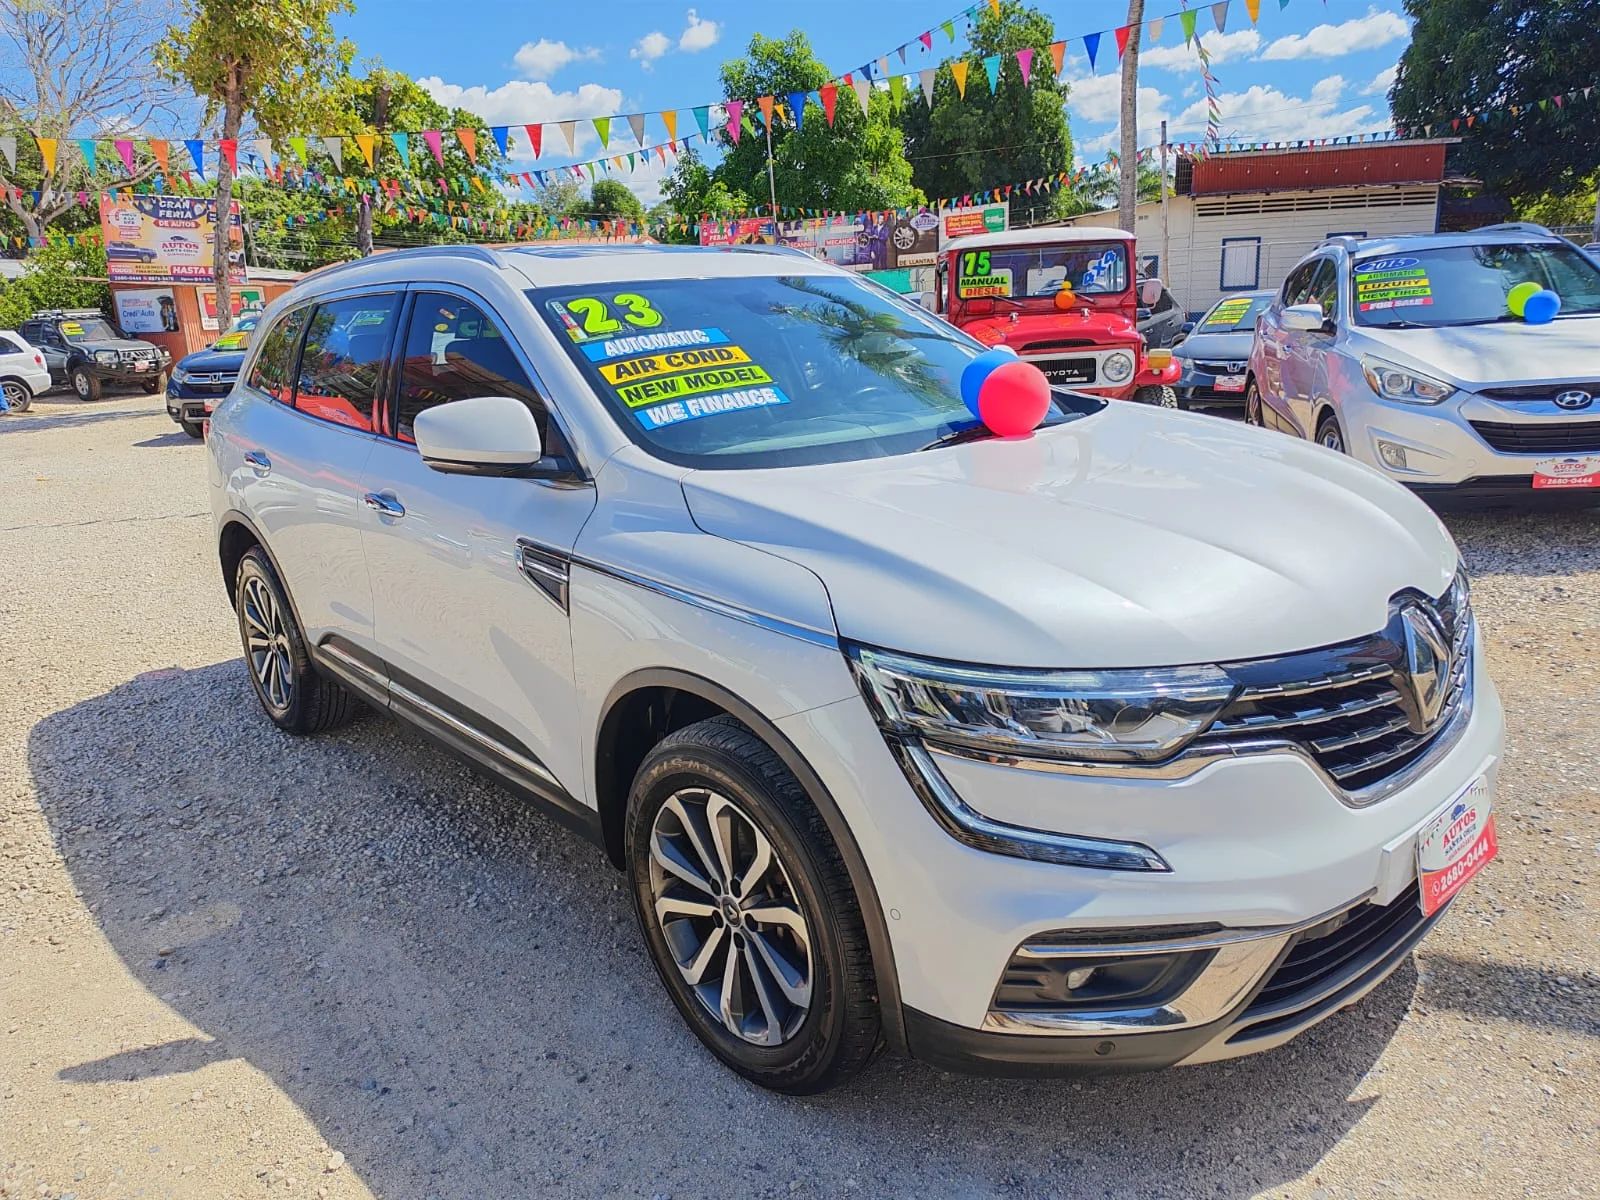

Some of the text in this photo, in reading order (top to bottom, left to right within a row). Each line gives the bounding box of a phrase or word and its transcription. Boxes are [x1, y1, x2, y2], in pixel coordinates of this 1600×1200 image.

[159, 200, 190, 209] GRAN
[159, 210, 193, 219] FERIA
[161, 242, 200, 250] AUTOS
[909, 257, 935, 265] LLANTAS
[1366, 260, 1405, 271] 2015
[172, 266, 206, 274] HASTA
[1367, 271, 1417, 279] AUTOMATIC
[960, 277, 1008, 286] MANUAL
[1363, 279, 1420, 290] LUXURY
[965, 286, 1005, 297] DIESEL
[1362, 288, 1427, 300] NEW TIRES
[1369, 301, 1392, 309] FOR
[566, 293, 663, 334] 23
[603, 328, 711, 358] AUTOMATIC
[615, 347, 740, 380] AIR COND.
[1042, 368, 1080, 377] OYOTA
[624, 366, 764, 402] NEW MODEL
[646, 387, 780, 426] WE FINANCE
[1442, 808, 1477, 849] AUTOS
[1440, 838, 1489, 892] 2680-0444
